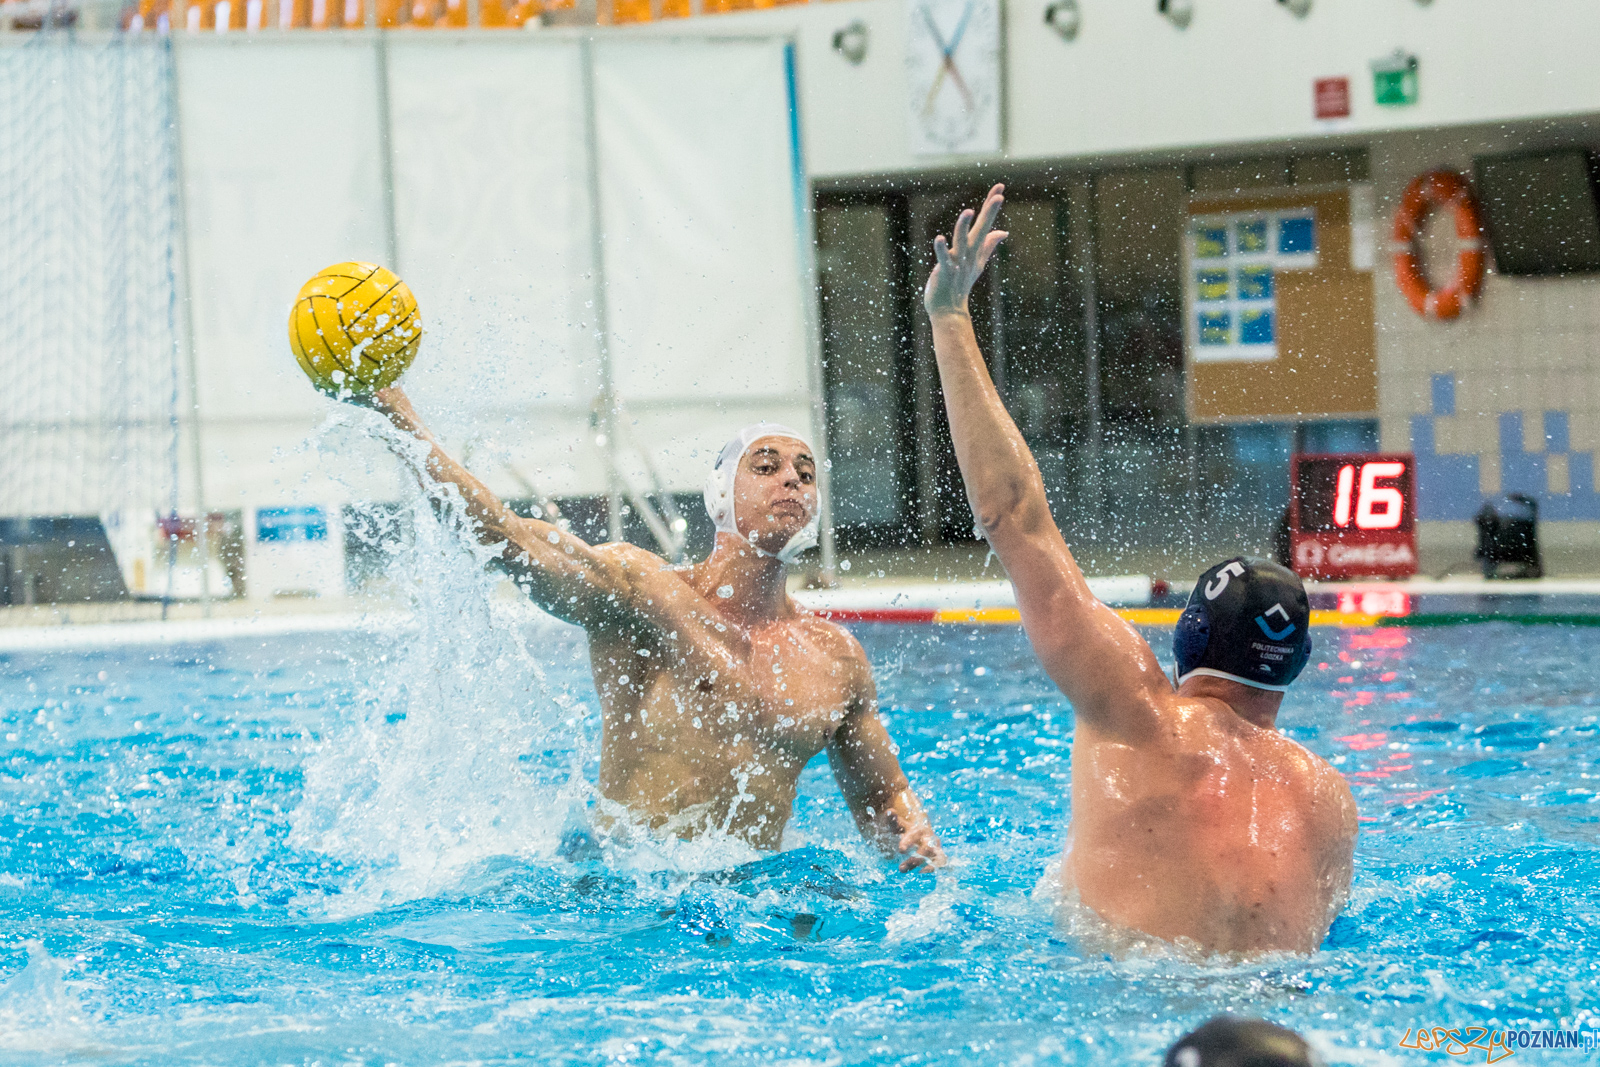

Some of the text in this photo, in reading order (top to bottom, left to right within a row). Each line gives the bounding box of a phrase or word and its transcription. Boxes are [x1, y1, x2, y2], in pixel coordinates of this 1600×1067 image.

[1333, 461, 1406, 530] 16
[1204, 561, 1246, 601] 5
[1251, 642, 1294, 654] POLITECHNIKA
